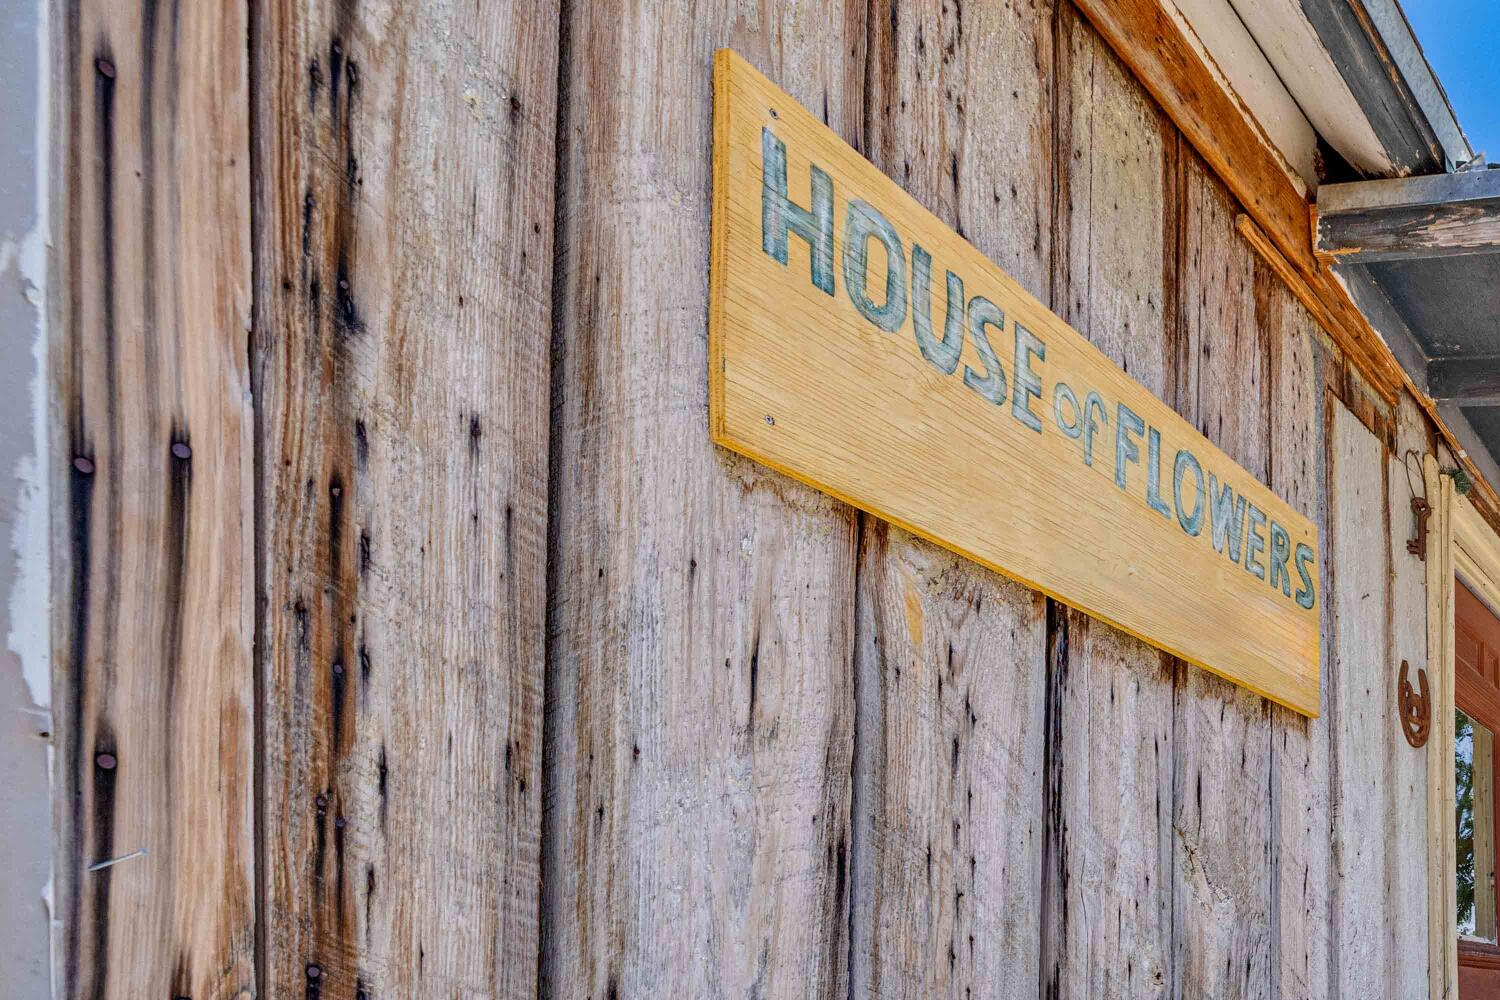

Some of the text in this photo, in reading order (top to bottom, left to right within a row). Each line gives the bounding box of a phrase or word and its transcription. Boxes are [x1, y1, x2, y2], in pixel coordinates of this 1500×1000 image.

[761, 127, 1316, 609] HOUSE of FLOWERS
